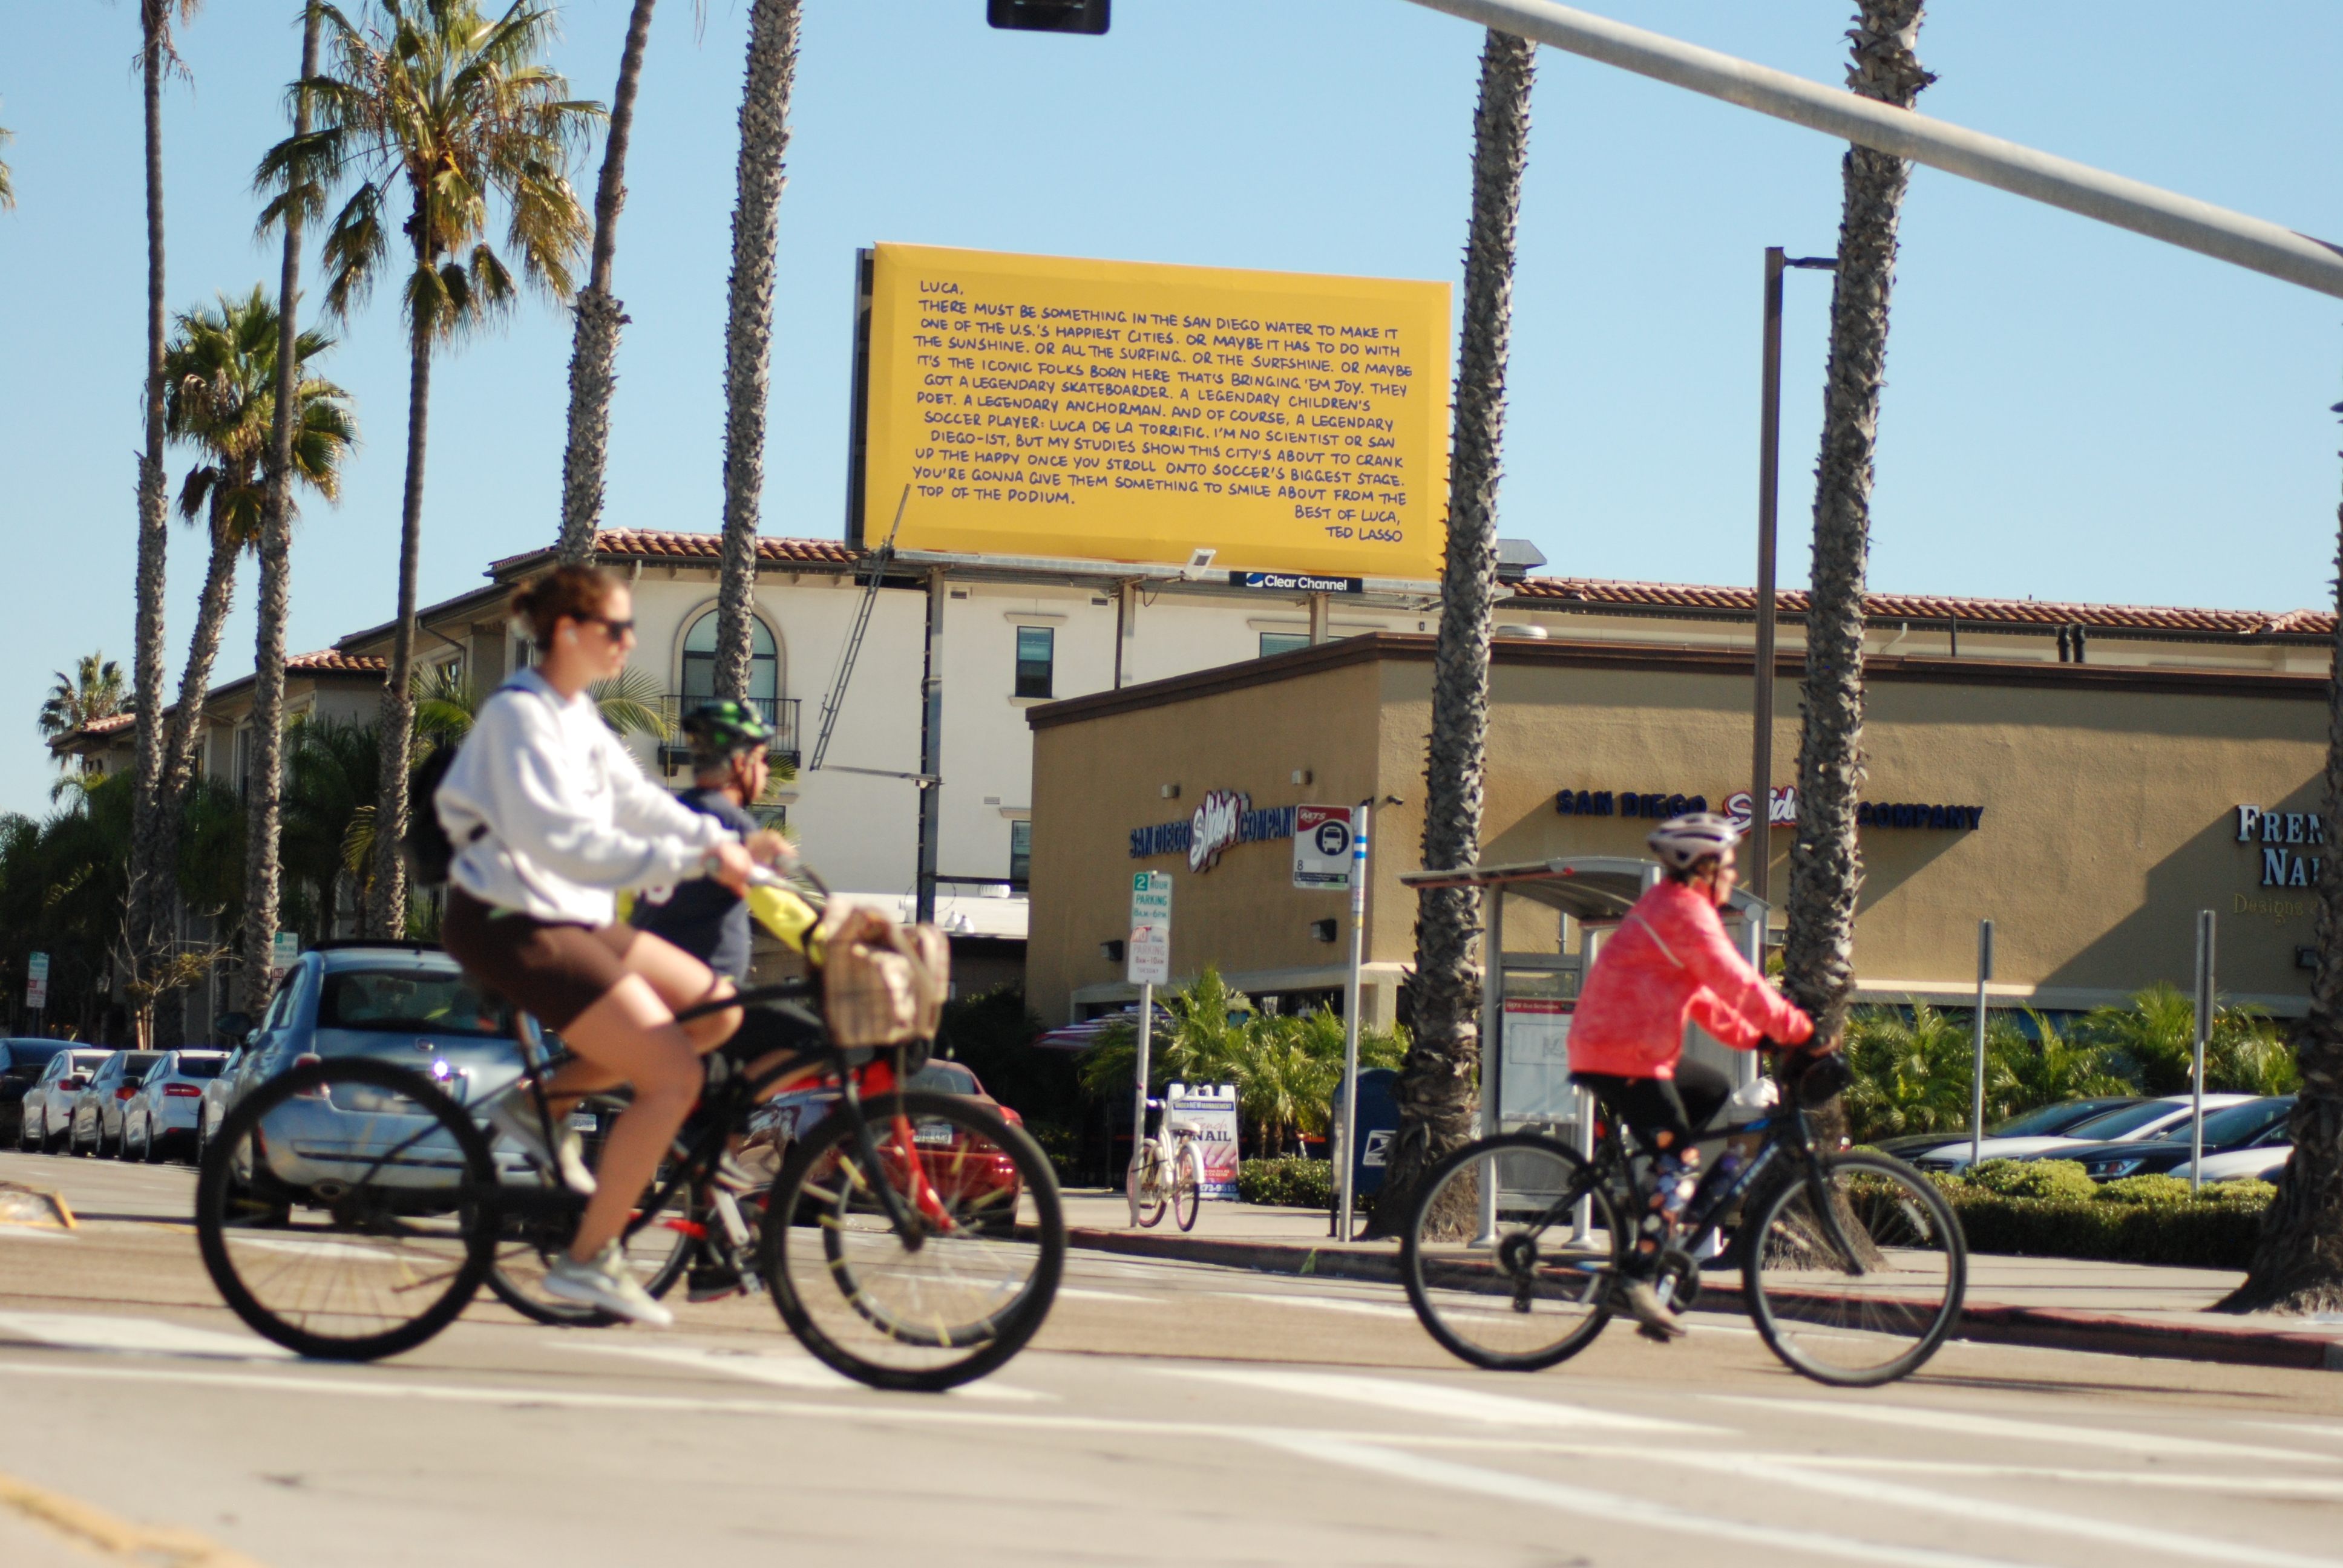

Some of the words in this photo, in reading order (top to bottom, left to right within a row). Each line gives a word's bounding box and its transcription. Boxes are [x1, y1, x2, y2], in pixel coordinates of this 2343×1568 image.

[920, 281, 963, 295] LUCA,
[919, 299, 966, 314] THERE
[974, 304, 1014, 316] MUST
[1020, 305, 1036, 318] BE
[1041, 307, 1127, 322] SOMETHING
[1133, 313, 1147, 324] IN
[1150, 314, 1178, 326] THE
[1183, 316, 1211, 328] SAN
[1216, 318, 1260, 331] DIEGO
[1265, 322, 1313, 335] WATER
[1317, 325, 1335, 336] TO
[1340, 326, 1378, 338] MAKE
[1385, 329, 1398, 339] IT
[921, 318, 948, 330] ONE
[954, 321, 971, 332] OF
[975, 322, 1005, 334] THE
[1056, 327, 1121, 340] HAPPIEST
[1128, 330, 1180, 345] CITIES.
[1186, 333, 1207, 345] OR
[1213, 335, 1263, 350] MAYBE
[1267, 340, 1279, 350] IT
[1284, 341, 1310, 352] HAS
[1316, 342, 1335, 353] TO
[1340, 343, 1359, 354] DO
[1365, 345, 1400, 357] WITH
[913, 335, 942, 347] THE
[948, 337, 1029, 353] SUNSHINE.
[1035, 342, 1055, 354] OR
[1062, 344, 1086, 356] ALL
[1088, 345, 1113, 359] THE
[1119, 347, 1185, 362] SURFING.
[1193, 351, 1213, 364] OR
[1217, 354, 1244, 366] THE
[1251, 356, 1333, 371] SURFSHINE.
[1341, 361, 1359, 373] OR
[1365, 364, 1412, 376] MAYBE
[918, 355, 940, 368] IT'S
[948, 358, 974, 370] THE
[983, 360, 1032, 373] ICONIC
[1038, 363, 1084, 376] FOLKS
[1090, 365, 1126, 379] BORN
[1132, 369, 1170, 382] HERE
[1178, 371, 1224, 384] THAT'S
[1231, 373, 1300, 388] BRINGING
[1305, 379, 1330, 391] 'EM
[1335, 380, 1363, 395] JOY.
[1370, 383, 1406, 397] THEY
[925, 374, 953, 386] GOT
[959, 376, 968, 387] A
[973, 377, 1055, 394] LEGENDARY
[1061, 382, 1173, 399] SKATEBOARDER.
[1180, 388, 1188, 400] A
[1198, 390, 1279, 407] LEGENDARY
[1289, 396, 1370, 411] CHILDREN'S
[917, 391, 957, 405] POET.
[964, 394, 972, 405] A
[978, 396, 1058, 413] LEGENDARY
[1066, 400, 1165, 416] ANCHORMAN.
[1172, 407, 1201, 419] AND
[1207, 410, 1224, 421] OF
[1230, 410, 1289, 425] COURSE,
[1296, 414, 1305, 425] A
[1312, 415, 1393, 432] LEGENDARY
[925, 411, 981, 425] SOCCER
[988, 414, 1043, 428] PLAYER:
[1050, 420, 1086, 432] LUCA
[1093, 421, 1110, 433] DE
[1116, 422, 1133, 433] LA
[1139, 423, 1209, 438] TORRIFIC.
[1214, 427, 1236, 439] I'M
[1240, 429, 1260, 440] NO
[1266, 430, 1339, 445] SCIENTIST
[1345, 436, 1362, 446] OR
[1368, 437, 1395, 448] SAN
[916, 448, 934, 459] UP
[939, 449, 969, 462] THE
[975, 452, 1019, 465] HAPPY
[1027, 455, 1067, 467] ONCE
[1073, 457, 1099, 469] YOU
[1106, 458, 1156, 472] STROLL
[1166, 462, 1207, 475] ONTO
[1213, 463, 1285, 480] SOCCER'S
[1291, 468, 1351, 483] BIGGEST
[1357, 472, 1404, 486] STAGE.
[931, 430, 1009, 446] DIEGO-IST,
[1017, 434, 1043, 447] BUT
[1048, 437, 1069, 448] MY
[1074, 437, 1135, 453] STUDIES
[1142, 442, 1185, 455] SHOW
[1188, 445, 1220, 457] THIS
[1226, 448, 1271, 460] CITY'S
[1277, 449, 1325, 463] ABOUT
[1331, 453, 1350, 465] TO
[1356, 454, 1403, 468] CRANK
[913, 466, 965, 480] YOU'RE
[972, 469, 1023, 482] GONNA
[1029, 472, 1060, 486] GIVE
[1067, 474, 1107, 487] THEM
[1115, 476, 1198, 492] SOMETHING
[1204, 483, 1222, 493] TO
[1228, 483, 1271, 497] SMILE
[1278, 486, 1326, 500] ABOUT
[1334, 489, 1374, 501] FROM
[1378, 492, 1406, 506] THE
[917, 485, 943, 497] TOP
[952, 487, 969, 498] OF
[974, 489, 1001, 500] THE
[1008, 489, 1074, 504] PODIUM.
[1295, 505, 1331, 519] BEST
[1338, 509, 1356, 521] OF
[1362, 510, 1400, 525] LUCA,
[1325, 526, 1353, 538] TED
[1359, 528, 1403, 542] LASSO
[1264, 575, 1296, 587] Clear
[1298, 577, 1347, 590] Channel
[1556, 789, 1613, 815] SAN
[1621, 792, 1708, 818] DIEGO
[1858, 801, 1984, 830] COMPANY
[2237, 805, 2324, 844] FREN
[1130, 827, 1153, 858] SAN
[1154, 820, 1191, 854] DIEGO
[1190, 791, 1240, 872] Sliders
[1136, 876, 1146, 889] 2
[1150, 881, 1168, 889] HOUR
[1297, 859, 1303, 871] 8
[1136, 895, 1167, 906] PARKING
[2233, 893, 2304, 926] Designs
[1133, 944, 1165, 956] PARKING
